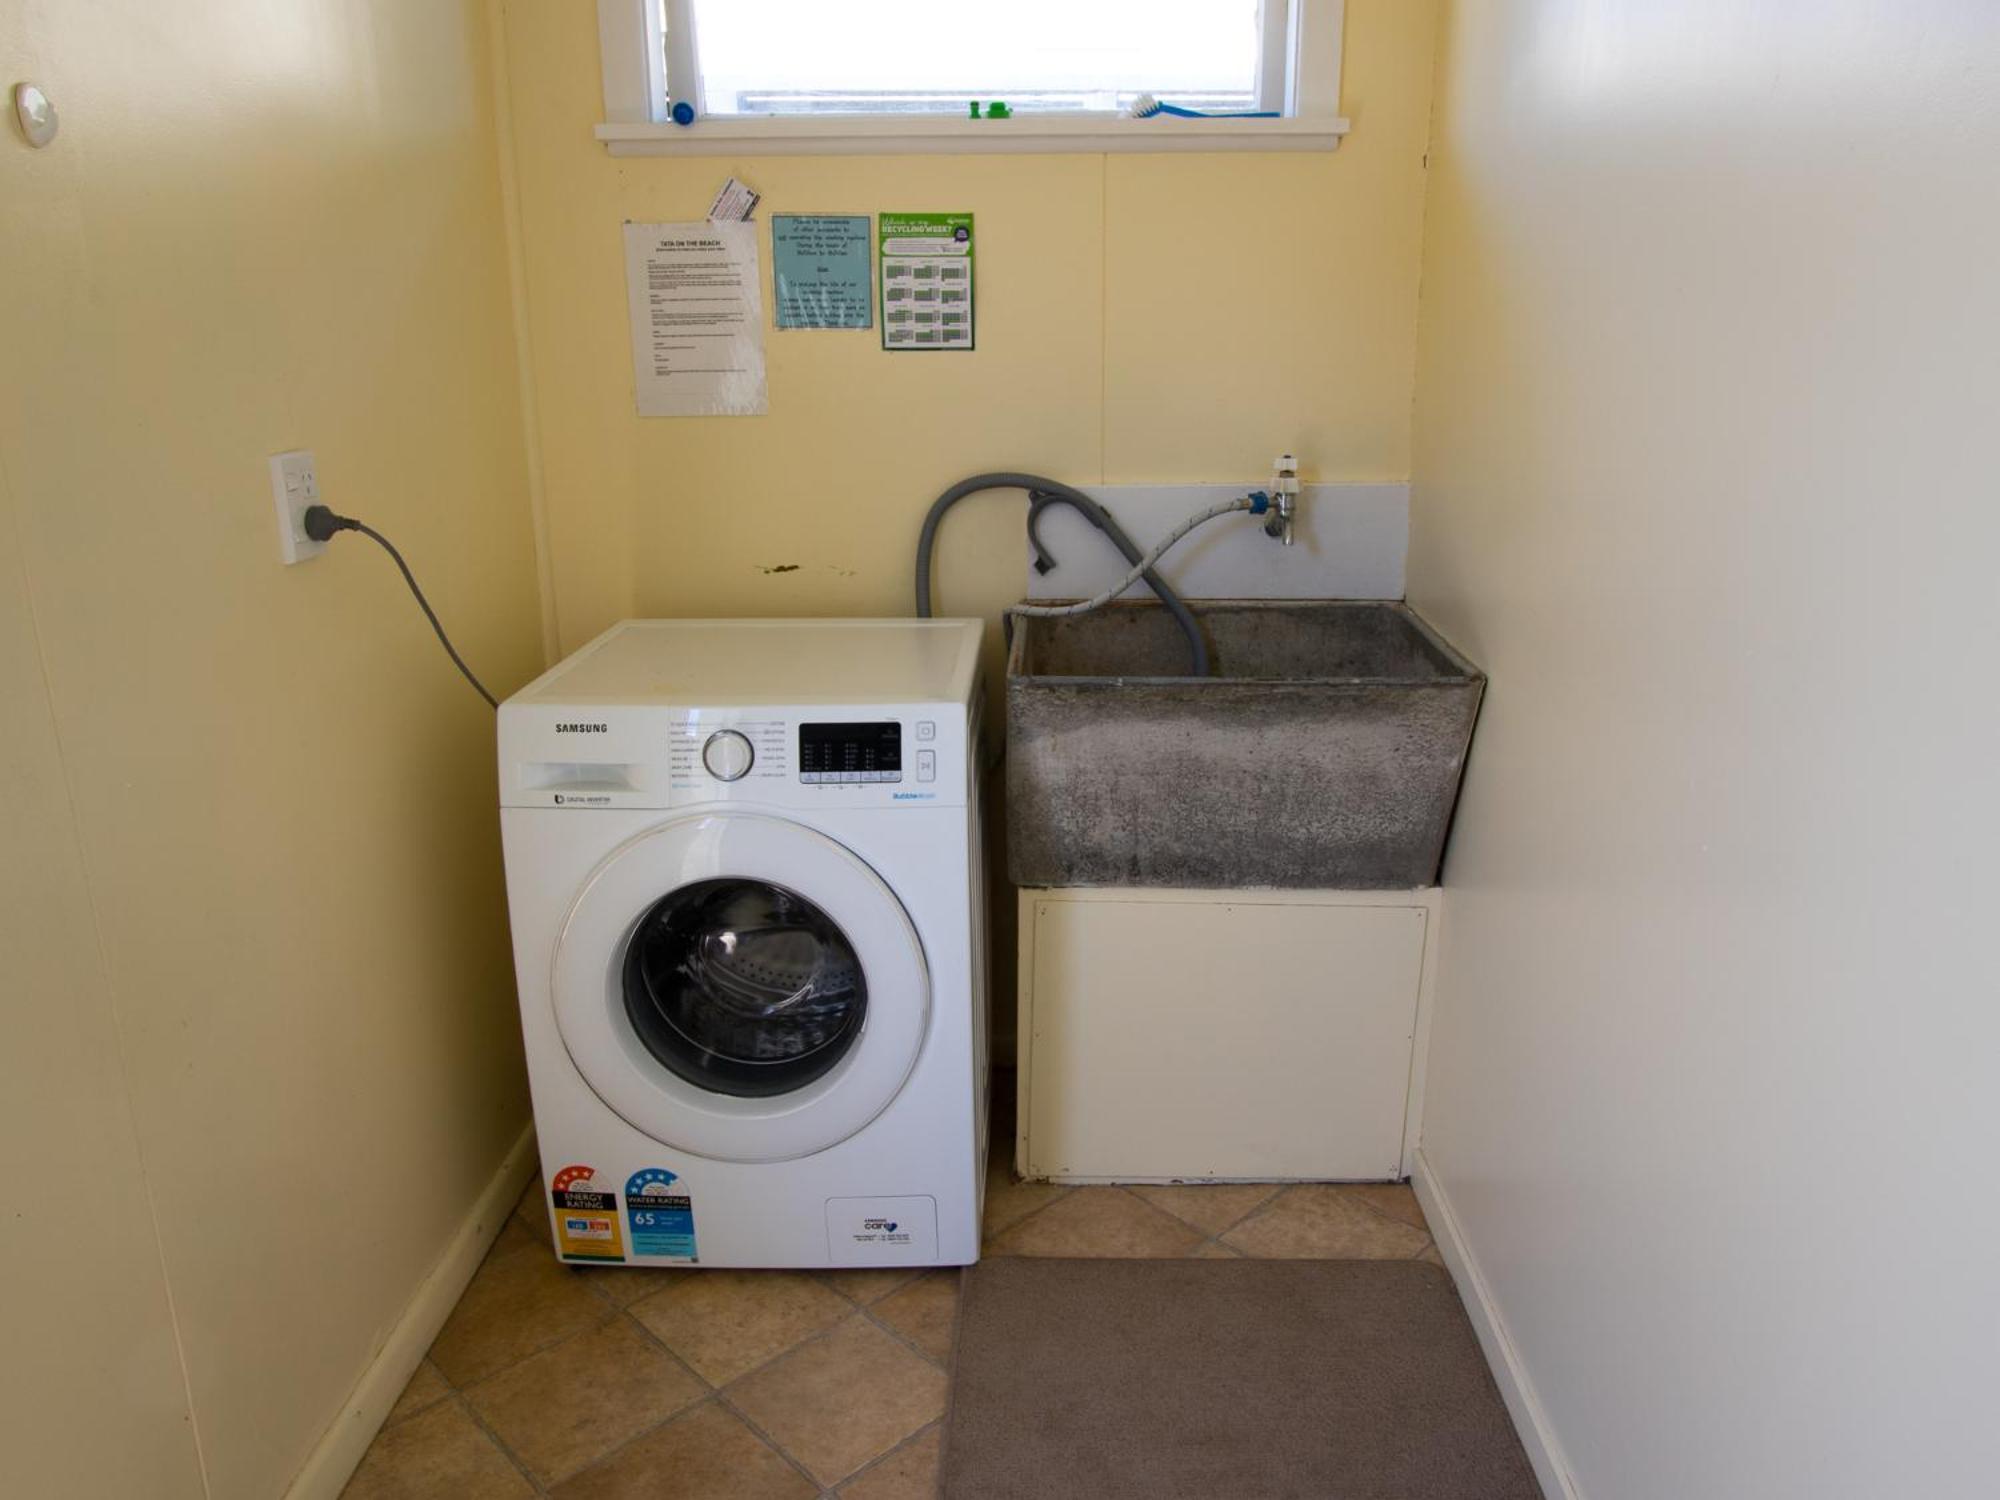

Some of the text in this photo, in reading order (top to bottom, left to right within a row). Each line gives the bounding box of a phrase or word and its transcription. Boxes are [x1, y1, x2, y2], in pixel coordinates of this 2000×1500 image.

[882, 224, 926, 233] RECYCLING
[555, 723, 608, 733] SAMSUNG
[564, 1193, 604, 1202] ENERGY
[627, 1196, 690, 1206] WATER RATING
[566, 1201, 604, 1209] RATING
[634, 1212, 656, 1226] 65
